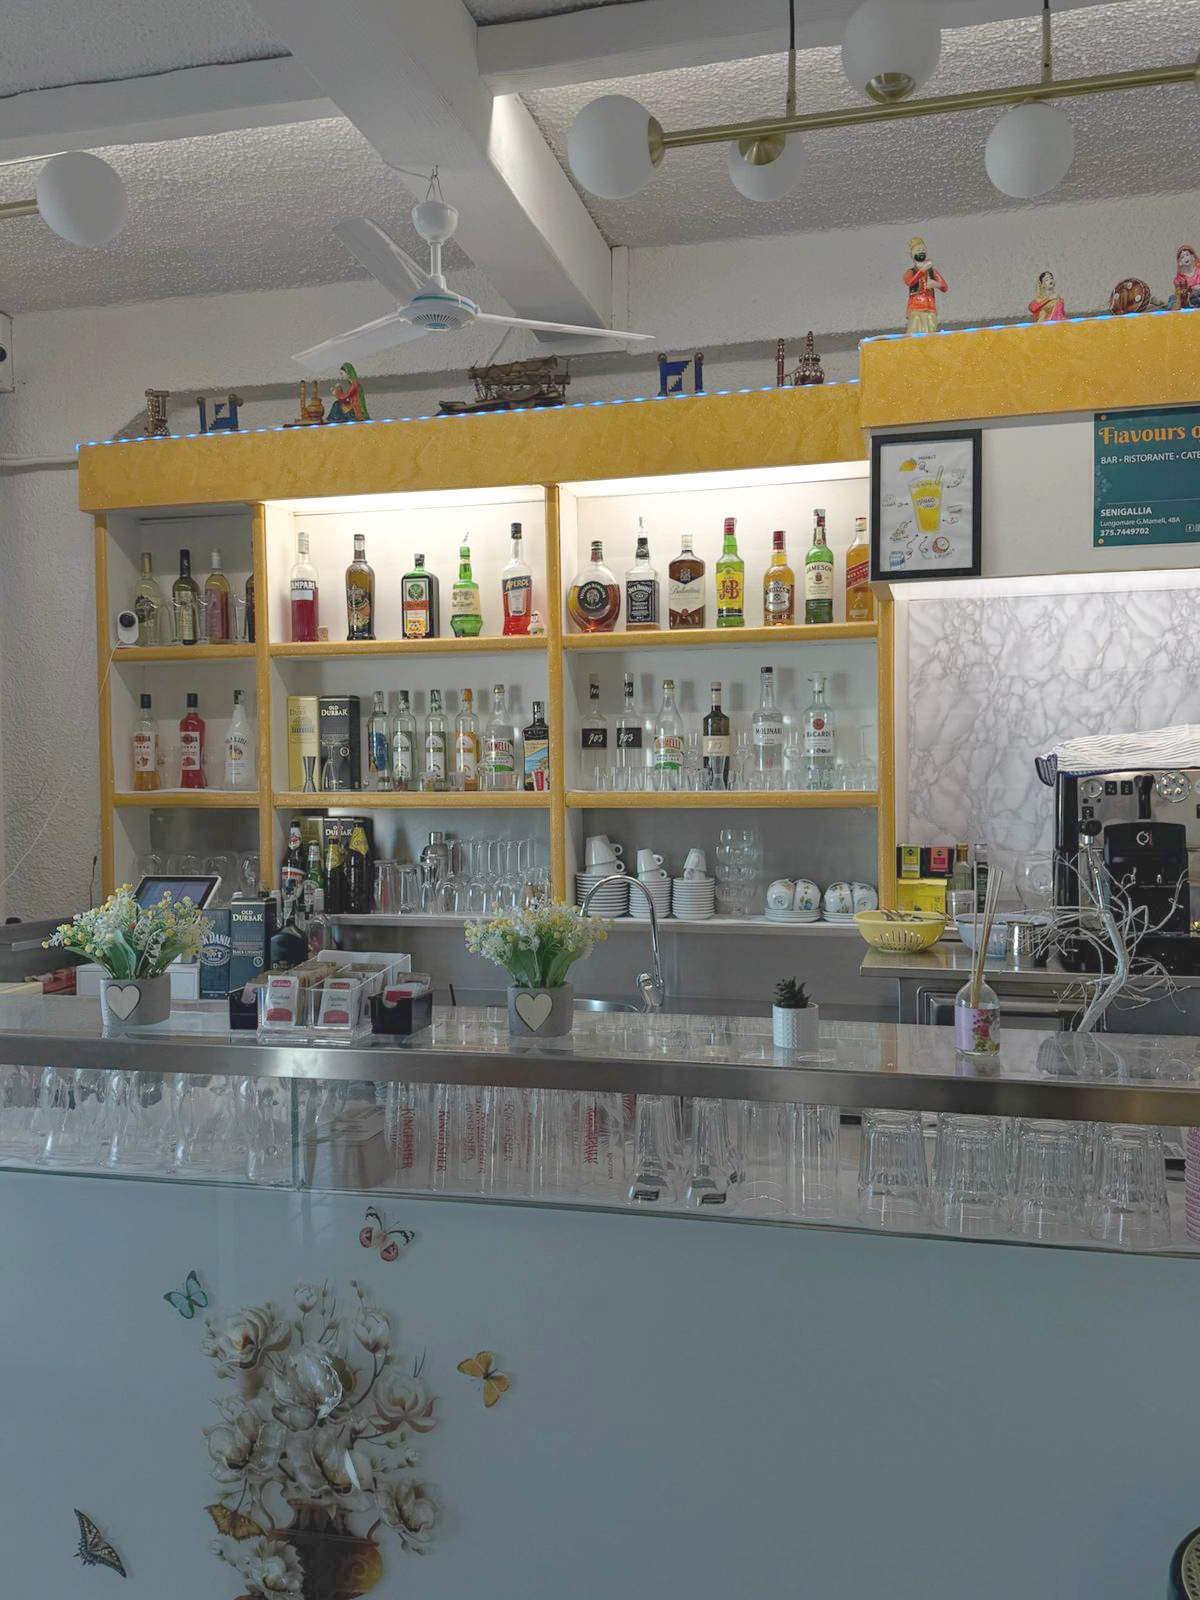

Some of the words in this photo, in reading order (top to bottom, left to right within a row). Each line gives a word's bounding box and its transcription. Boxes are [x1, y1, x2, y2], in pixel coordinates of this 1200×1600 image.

[1098, 426, 1186, 445] Flavours
[1101, 456, 1118, 465] BAR
[1124, 452, 1175, 463] RISTORANTE
[1101, 507, 1152, 517] SENIGALLIA
[1101, 519, 1135, 528] Lungomare
[1101, 527, 1150, 537] 375.7449702
[806, 564, 832, 574] JAMESON
[291, 581, 315, 589] AMPARI
[232, 914, 264, 922] DURBAR
[400, 1108, 415, 1169] KINGFISHER
[437, 1111, 449, 1171] KINGFISHER
